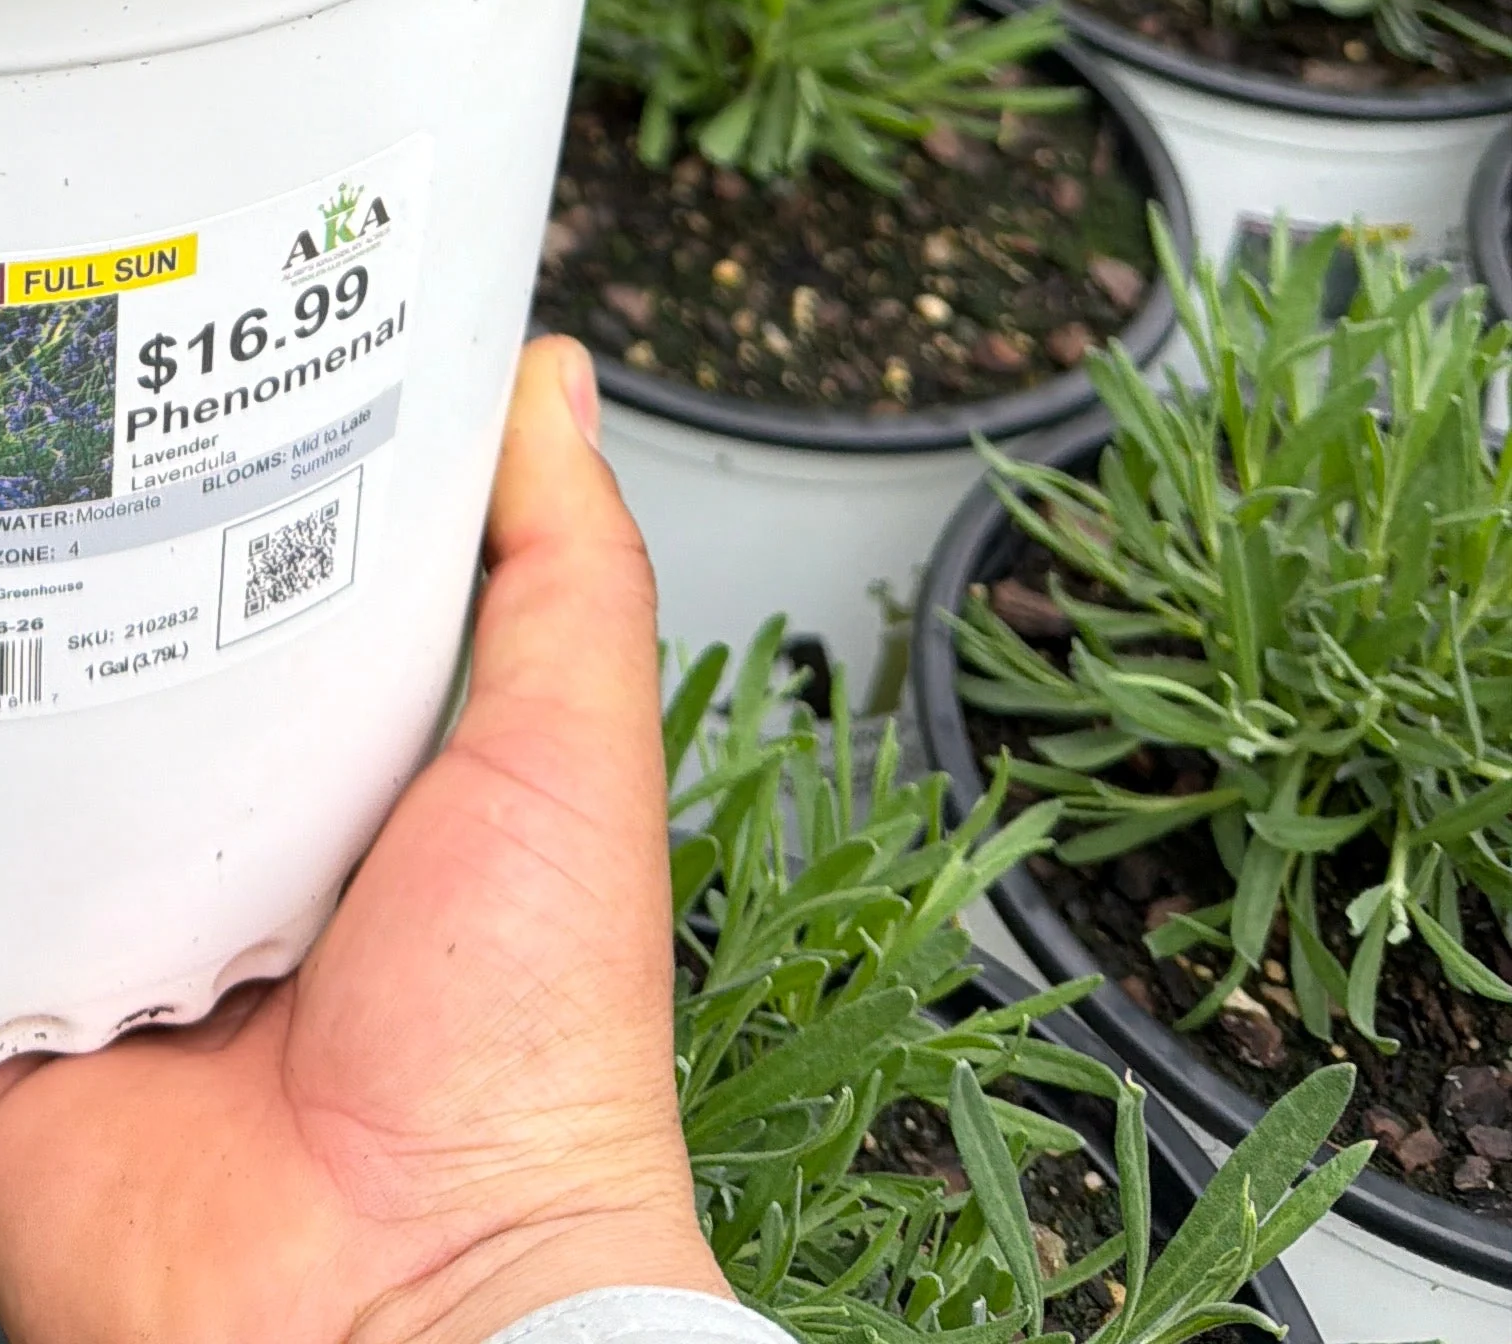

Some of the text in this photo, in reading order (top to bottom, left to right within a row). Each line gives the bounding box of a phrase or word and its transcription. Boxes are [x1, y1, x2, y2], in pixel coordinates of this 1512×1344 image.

[282, 196, 390, 270] AKA
[24, 247, 177, 295] FULL SUN
[137, 265, 369, 395] $16.99
[126, 300, 406, 442] Phenomenal
[131, 433, 219, 469] Lavender
[131, 449, 237, 491] Lavendula
[202, 408, 372, 494] BLOOMS: Mid to Late
[291, 439, 354, 481] Summer
[77, 495, 162, 523] Moderate
[68, 540, 80, 557] 4
[68, 606, 200, 651] SKU: 2102832
[86, 640, 189, 681] 1 Gal (3.79L)
